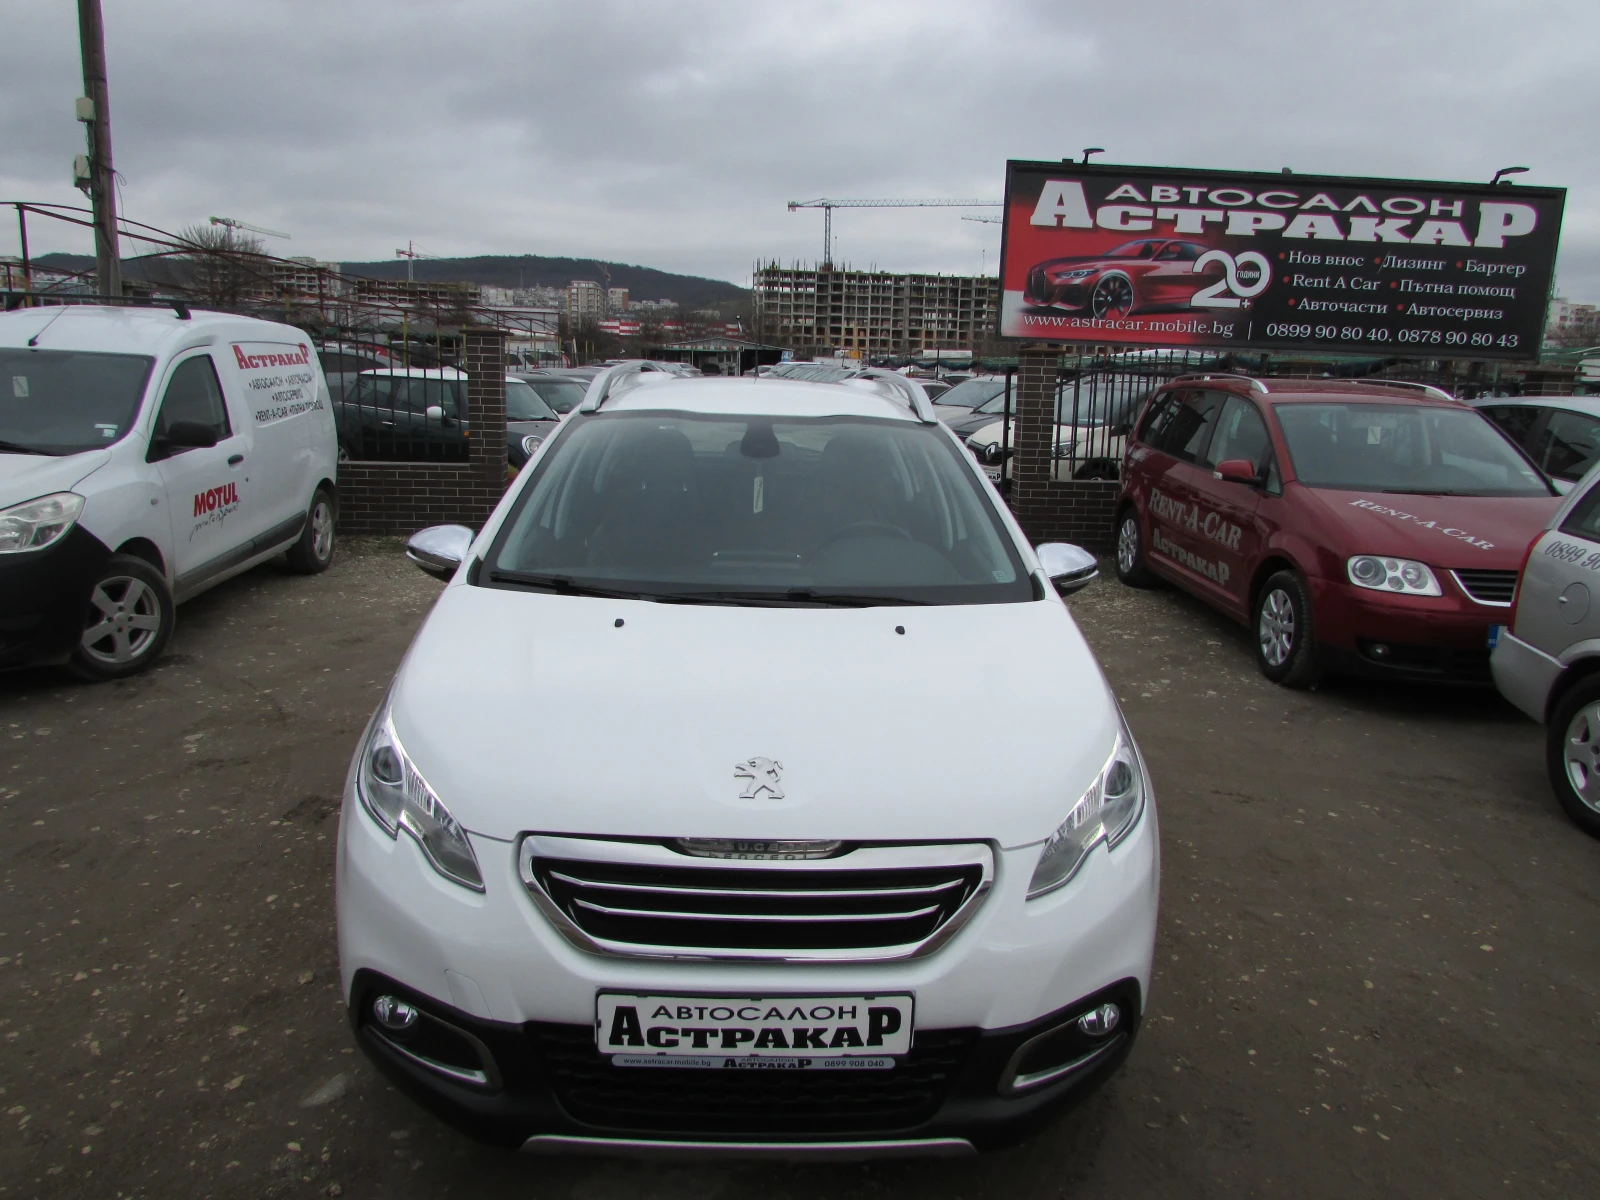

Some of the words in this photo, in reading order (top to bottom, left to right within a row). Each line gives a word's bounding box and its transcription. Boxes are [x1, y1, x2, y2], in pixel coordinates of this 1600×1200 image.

[1105, 184, 1464, 217] АВТОСАЛОН
[1288, 251, 1320, 266] Нов
[1325, 255, 1364, 267] внос
[1383, 255, 1446, 271] Лизинг
[1465, 259, 1526, 278] Бартер
[1292, 274, 1331, 288] Rent
[1334, 276, 1346, 289] A
[1350, 278, 1381, 291] Car
[1399, 279, 1453, 295] Пътна
[1457, 285, 1516, 299] помощ
[1297, 298, 1388, 315] Авточасти
[1406, 303, 1503, 321] Автосервиз
[1023, 315, 1234, 338] www.astracar.mobile.bg
[1266, 323, 1311, 338] 0899
[1315, 326, 1336, 339] 90
[1340, 327, 1362, 340] 80
[1366, 328, 1393, 343] 40,
[1398, 329, 1441, 344] 0878
[1445, 331, 1466, 345] 90
[1471, 333, 1492, 347] 80
[1496, 334, 1519, 348] 43
[258, 407, 288, 422] RENT-A-CAR
[193, 481, 238, 518] MOTUL
[1545, 540, 1587, 563] 0899
[651, 1005, 857, 1021] АВТОСАЛОН
[623, 1057, 712, 1067] www.astracar.mobile.bg
[824, 1060, 846, 1068] 0899
[849, 1060, 865, 1068] 908
